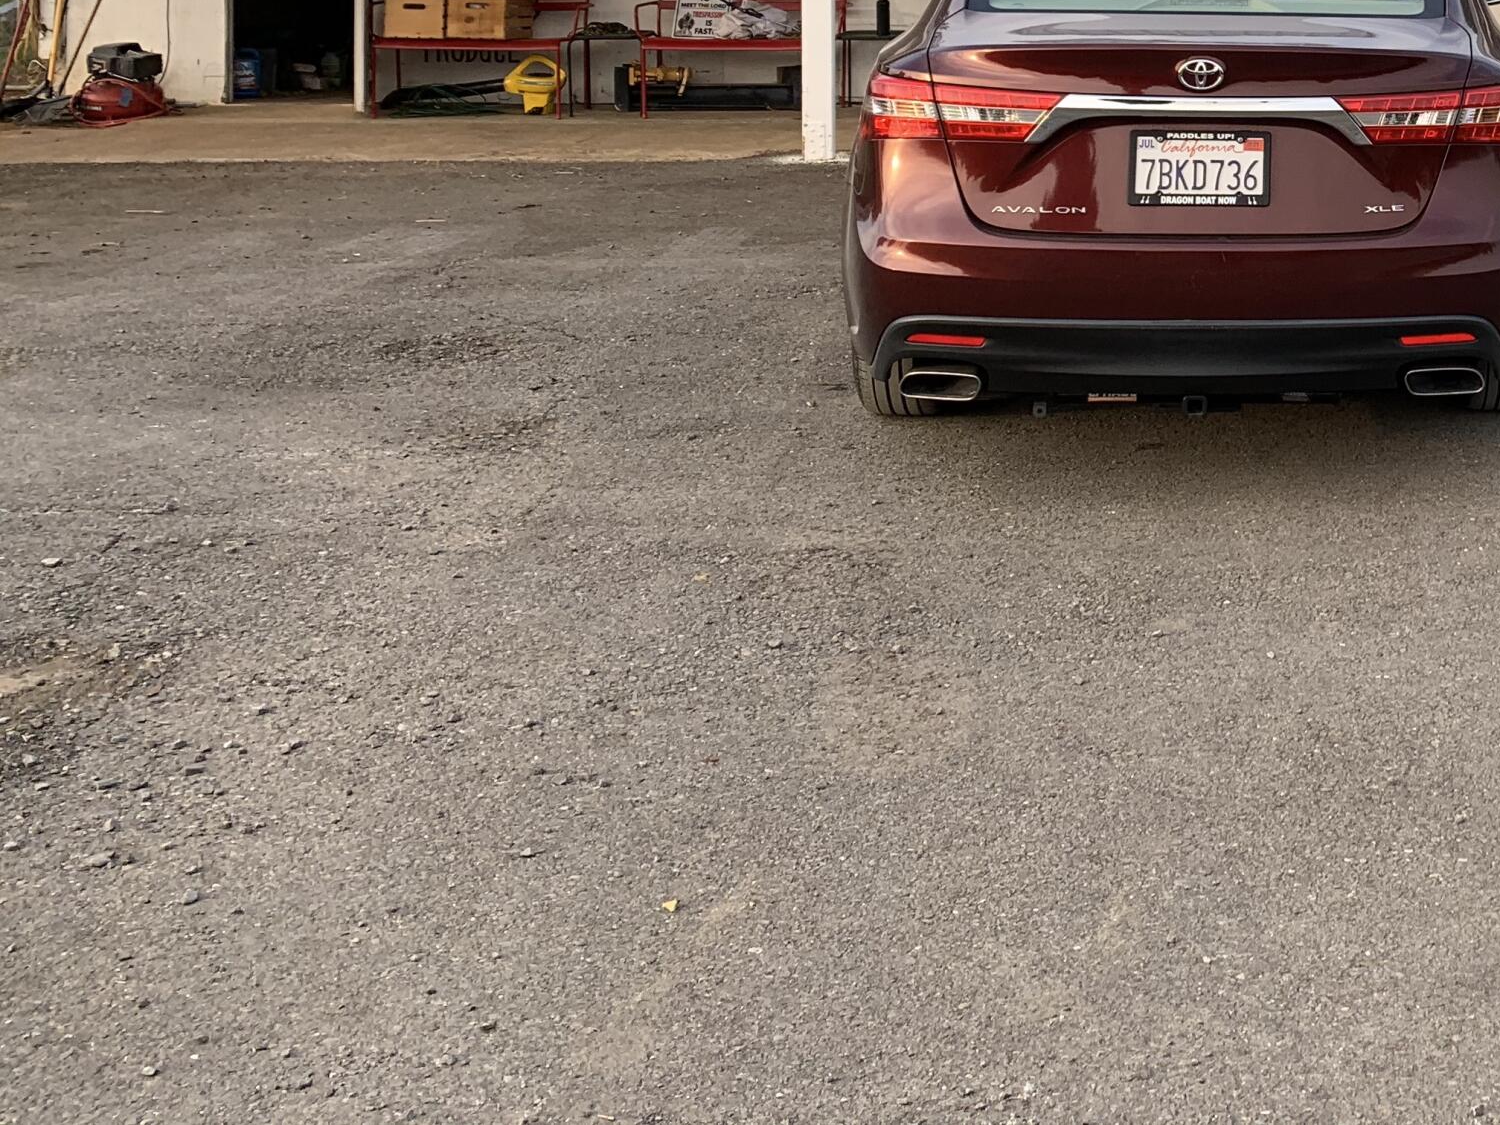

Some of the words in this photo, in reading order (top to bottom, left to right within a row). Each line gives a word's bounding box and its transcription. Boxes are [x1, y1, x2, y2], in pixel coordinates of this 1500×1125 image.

[1139, 139, 1155, 148] JUL
[1160, 140, 1244, 157] California
[1140, 159, 1259, 191] 7BKD736
[1160, 196, 1194, 205] DRAGON
[1195, 196, 1217, 205] BOAT
[1218, 196, 1237, 205] NOW
[991, 205, 1087, 214] AVALON
[1364, 203, 1405, 213] XLE
